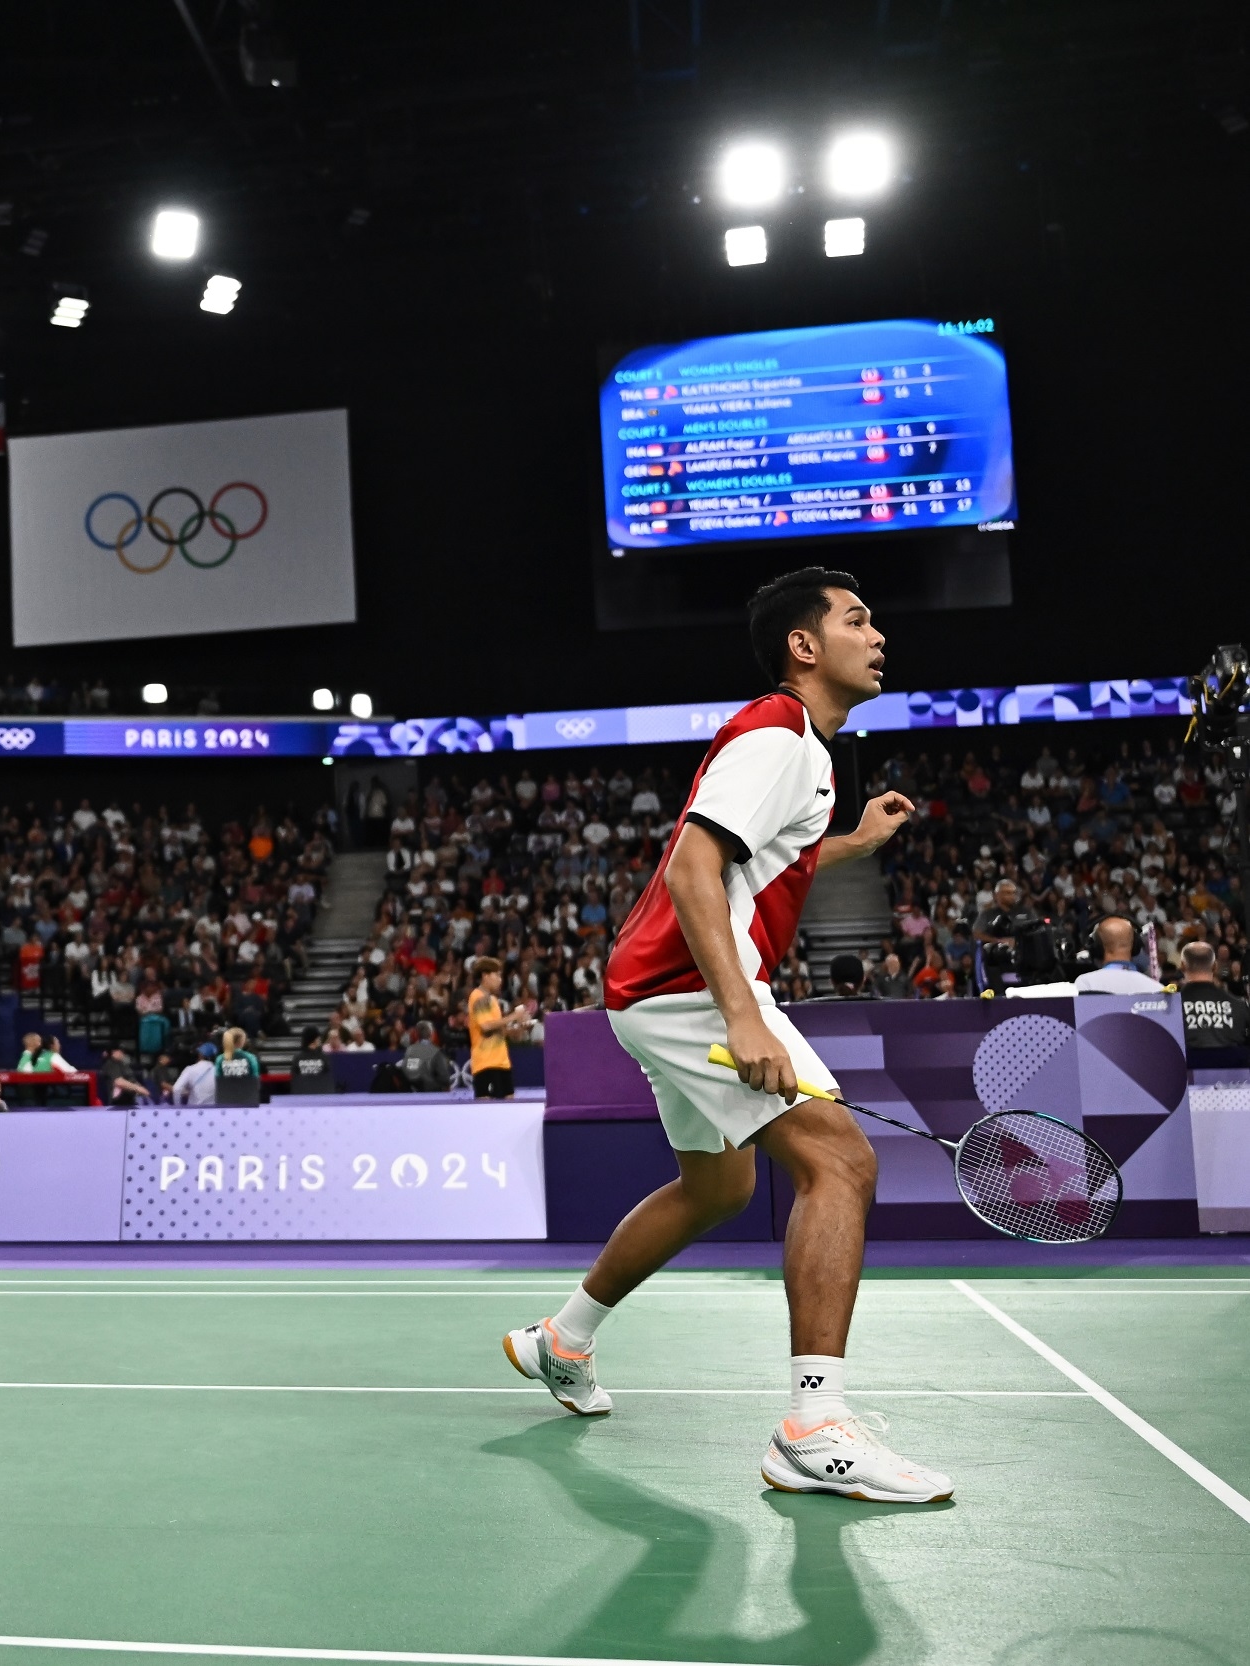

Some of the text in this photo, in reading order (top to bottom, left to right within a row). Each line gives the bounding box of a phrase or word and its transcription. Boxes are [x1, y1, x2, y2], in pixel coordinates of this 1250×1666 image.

[734, 358, 779, 373] SINGLES
[892, 366, 907, 379] 21
[615, 369, 654, 383] COURT
[717, 416, 768, 432] DOUBLES
[897, 424, 912, 437] 21
[618, 426, 658, 440] COURT
[622, 481, 671, 497] COURT 3
[686, 472, 792, 492] WOMEN'S DOUBLES
[902, 502, 918, 515] 21
[929, 500, 945, 513] 21
[204, 728, 270, 749] 2024
[1186, 1014, 1233, 1029] 2024
[352, 1153, 507, 1189] 2024
